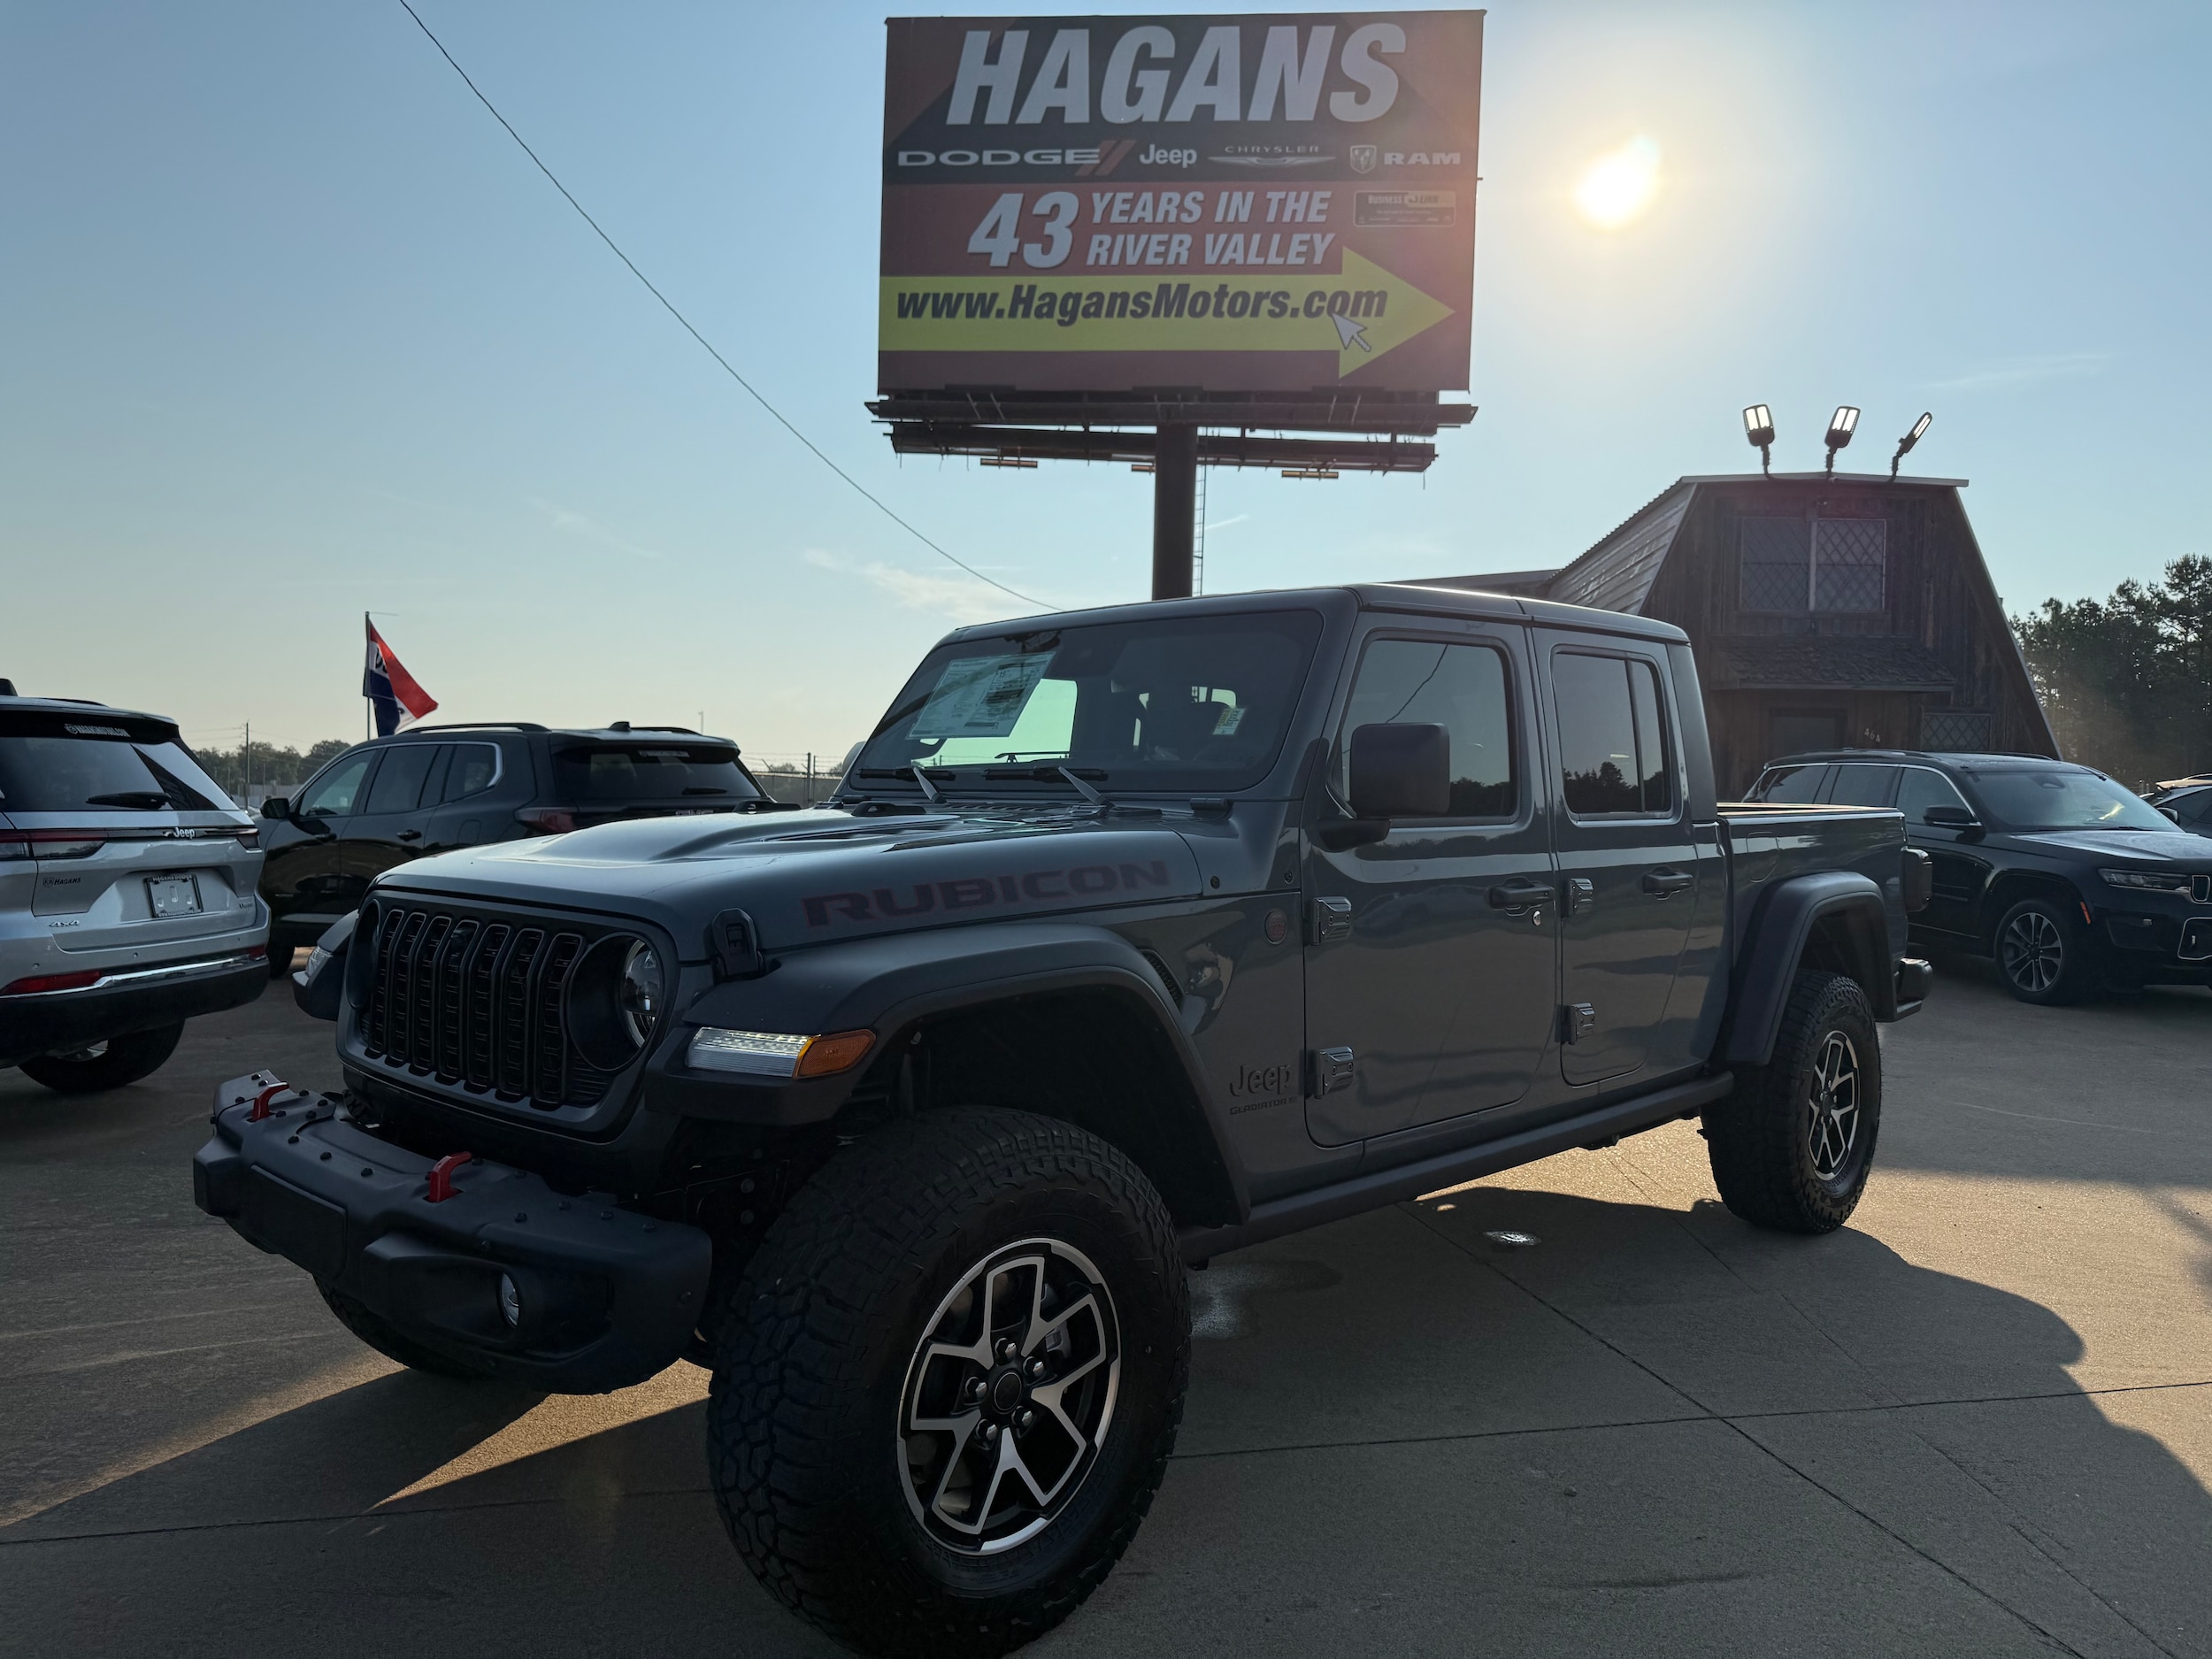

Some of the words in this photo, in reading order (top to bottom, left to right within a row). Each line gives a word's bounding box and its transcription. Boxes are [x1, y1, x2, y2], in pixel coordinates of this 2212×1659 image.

[945, 23, 1407, 125] HAGANS
[898, 147, 1101, 167] DODGE
[1139, 144, 1197, 168] Jeep
[1225, 145, 1320, 154] CHRYSLER
[1384, 152, 1461, 165] RAM
[1091, 191, 1205, 225] YEARS
[1214, 191, 1255, 224] IN
[1266, 191, 1332, 223] THE
[968, 191, 1080, 269] 43
[1087, 234, 1195, 266] RIVER
[1205, 233, 1335, 265] VALLEY
[897, 283, 1387, 327] www.HagansMotors.com
[1863, 728, 1881, 743] 464
[174, 826, 195, 840] Jeep
[54, 877, 81, 886] HAGANS
[803, 860, 1167, 928] RUBICON
[1229, 1064, 1291, 1097] Jeep
[1229, 1098, 1287, 1115] GLADIATOR
